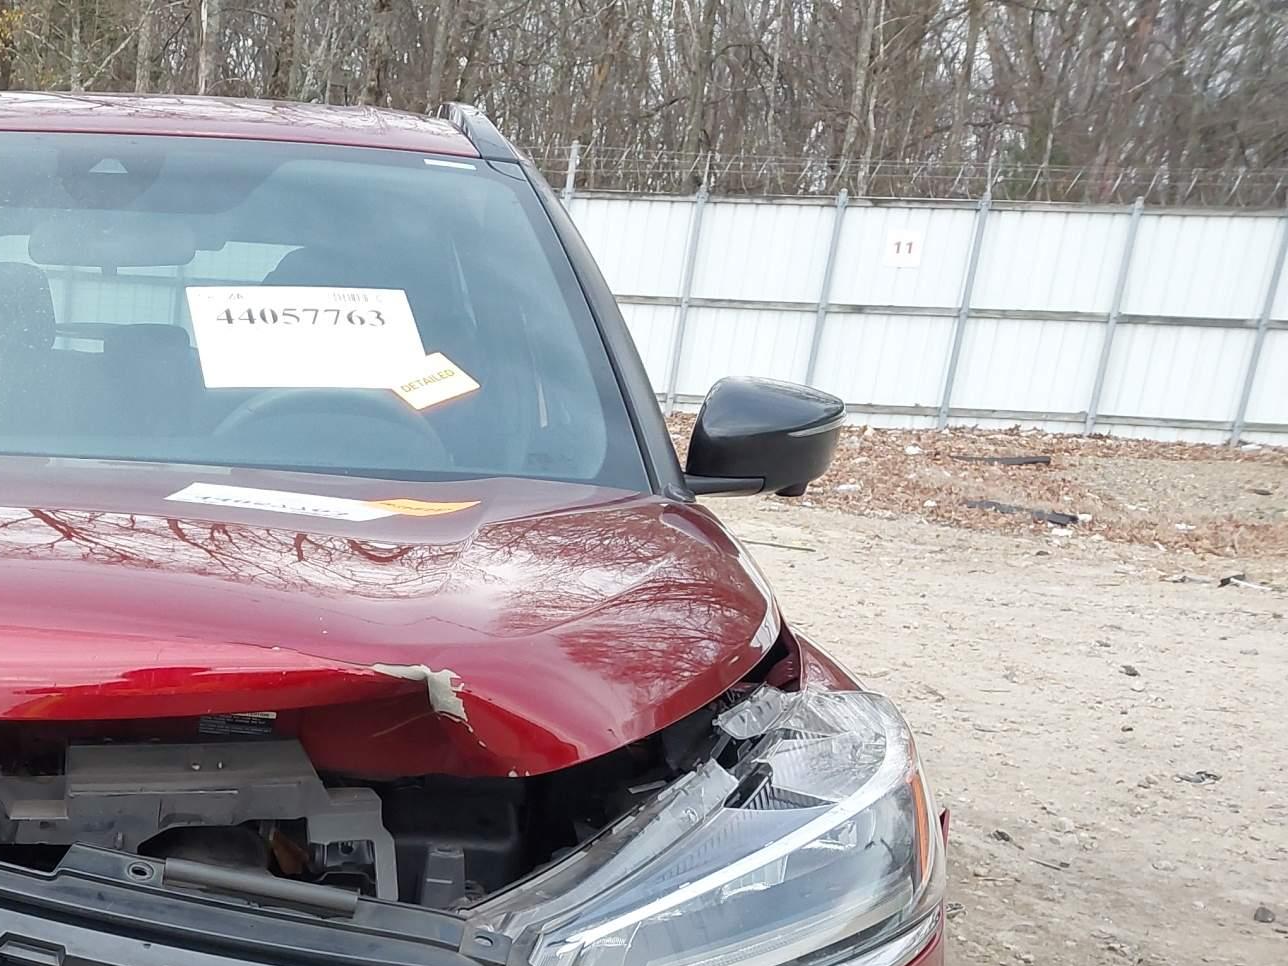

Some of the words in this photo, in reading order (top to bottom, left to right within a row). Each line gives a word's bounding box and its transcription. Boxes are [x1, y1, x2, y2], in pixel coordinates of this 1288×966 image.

[893, 240, 914, 255] 11
[216, 307, 386, 327] 44057763
[400, 368, 456, 393] DETAILED
